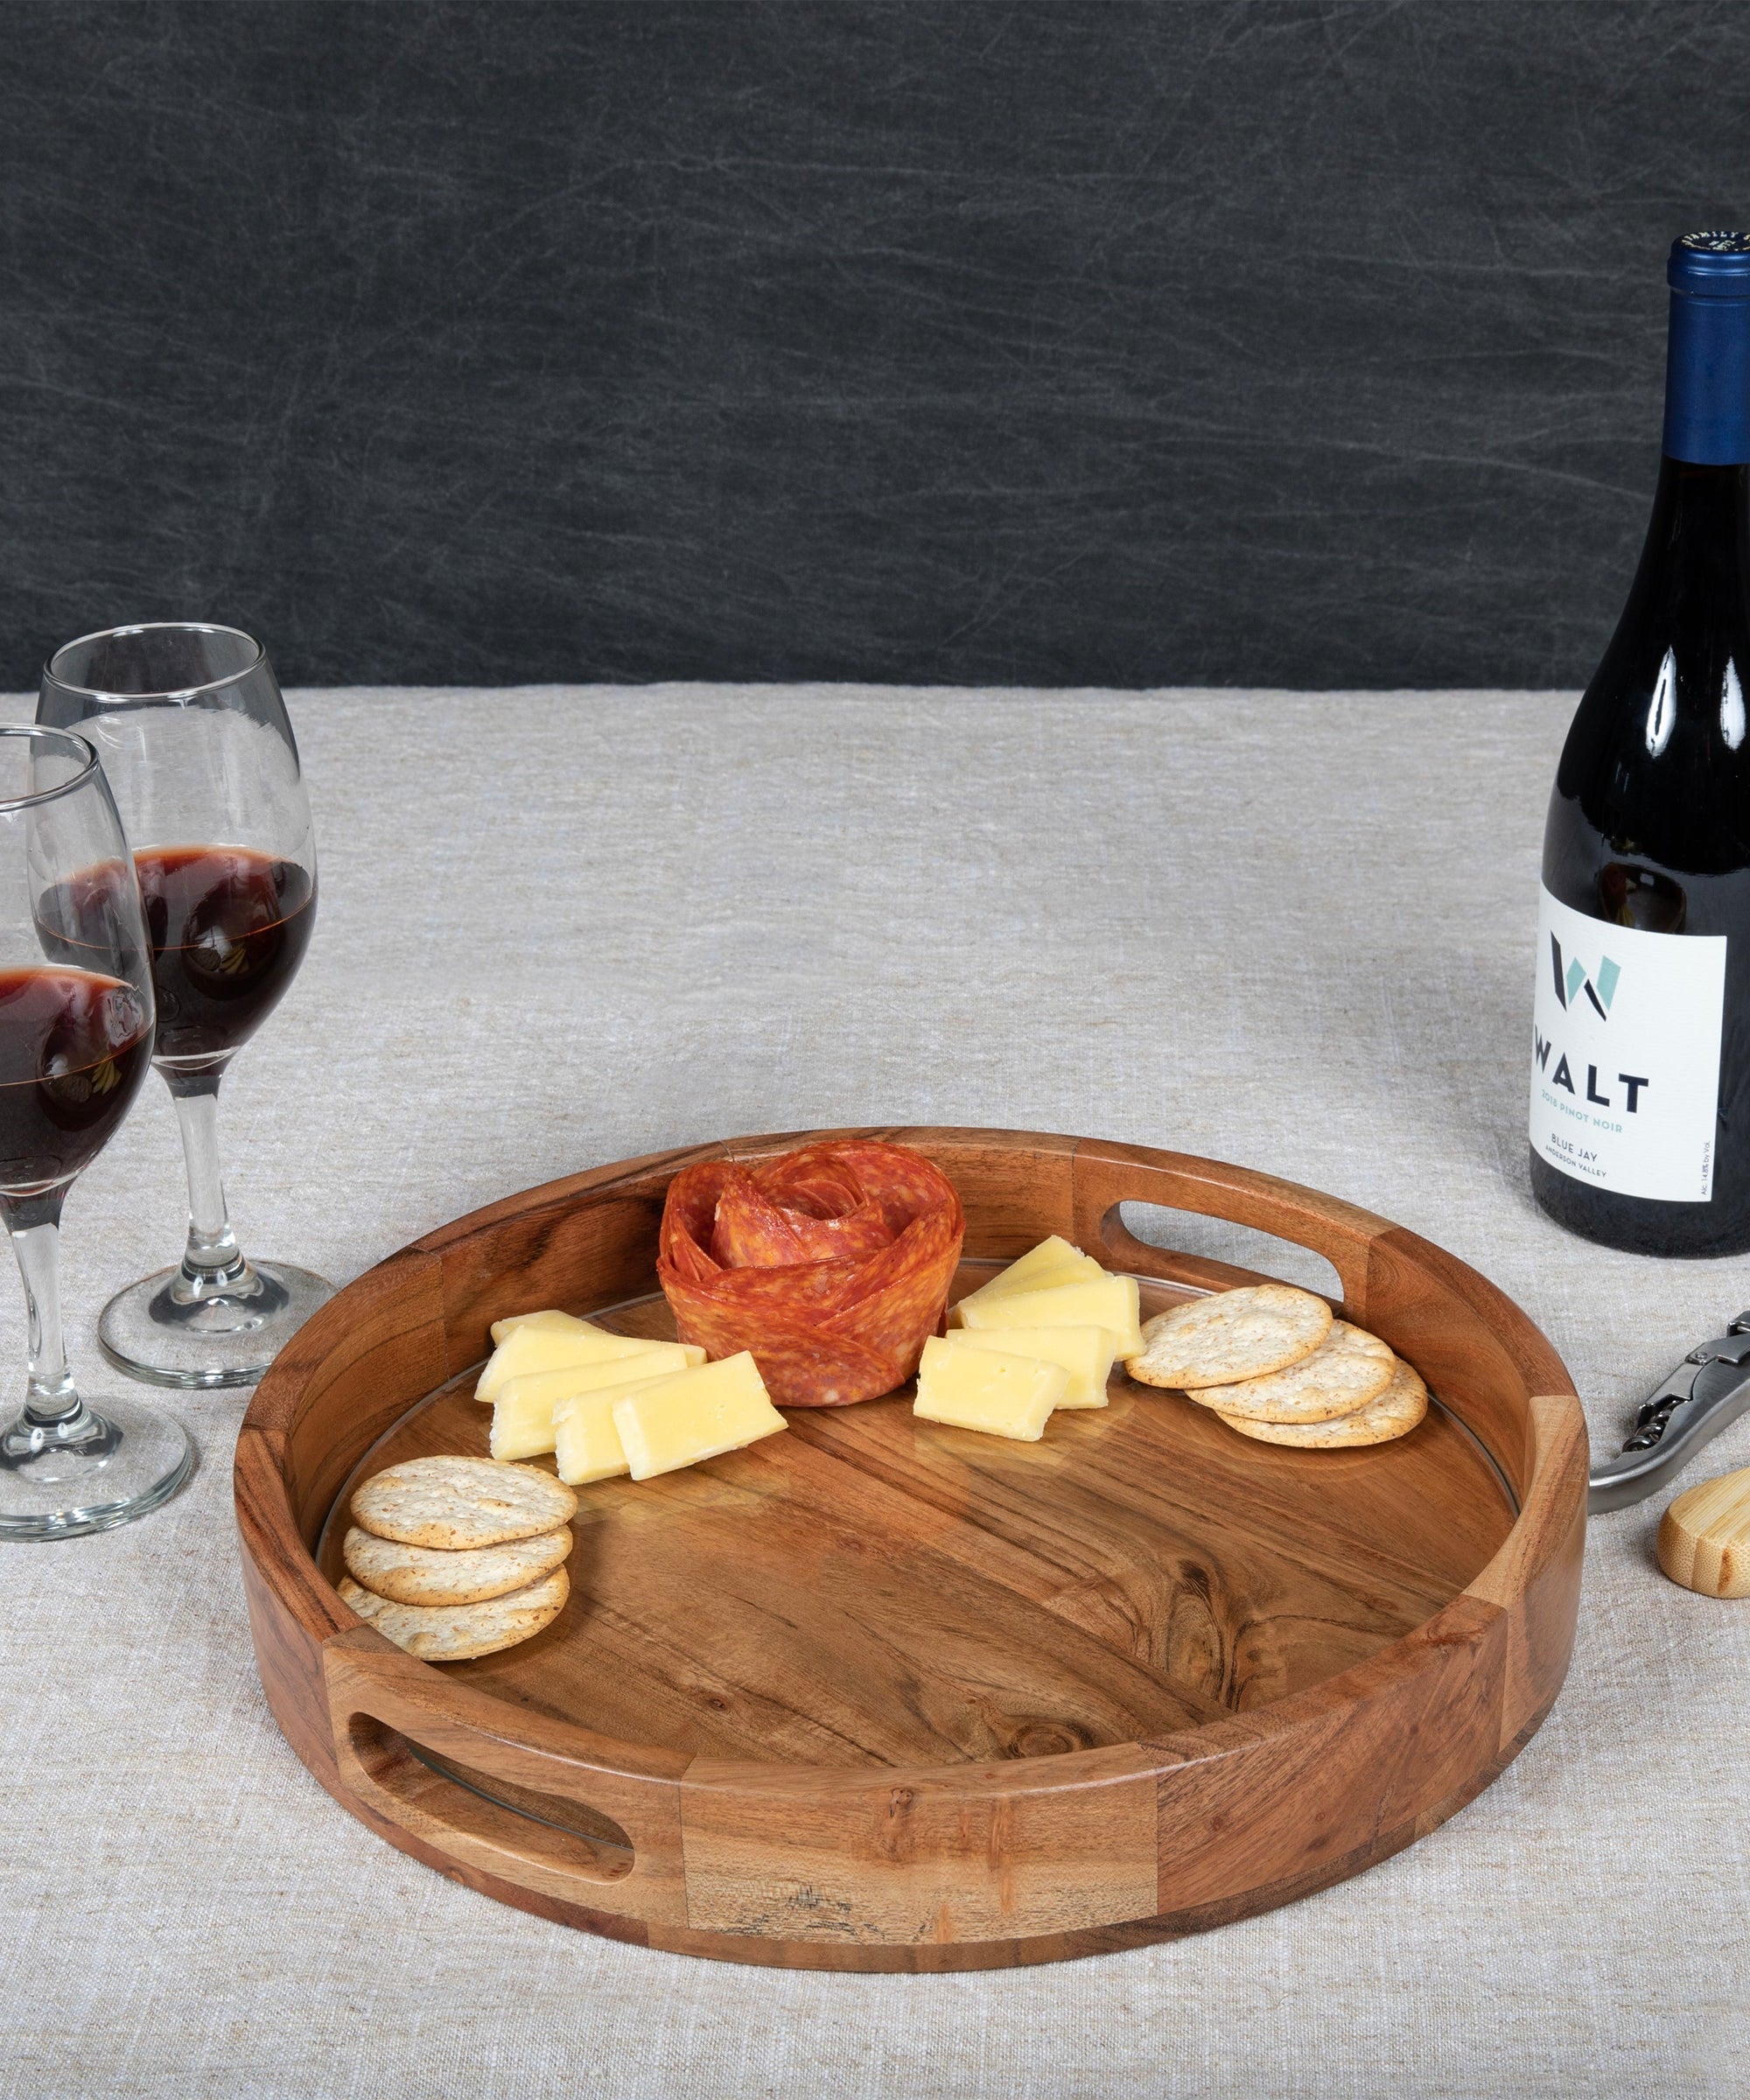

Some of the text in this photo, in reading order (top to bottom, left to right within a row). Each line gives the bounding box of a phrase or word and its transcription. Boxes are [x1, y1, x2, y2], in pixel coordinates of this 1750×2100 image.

[1535, 1024, 1649, 1114] WALT
[1560, 1102, 1590, 1124] PINOT
[1592, 1117, 1623, 1134] NOIR
[1545, 1144, 1607, 1179] ANDERSON VALLEY
[1550, 1133, 1598, 1163] BLUE JAY
[1702, 1154, 1711, 1163] by
